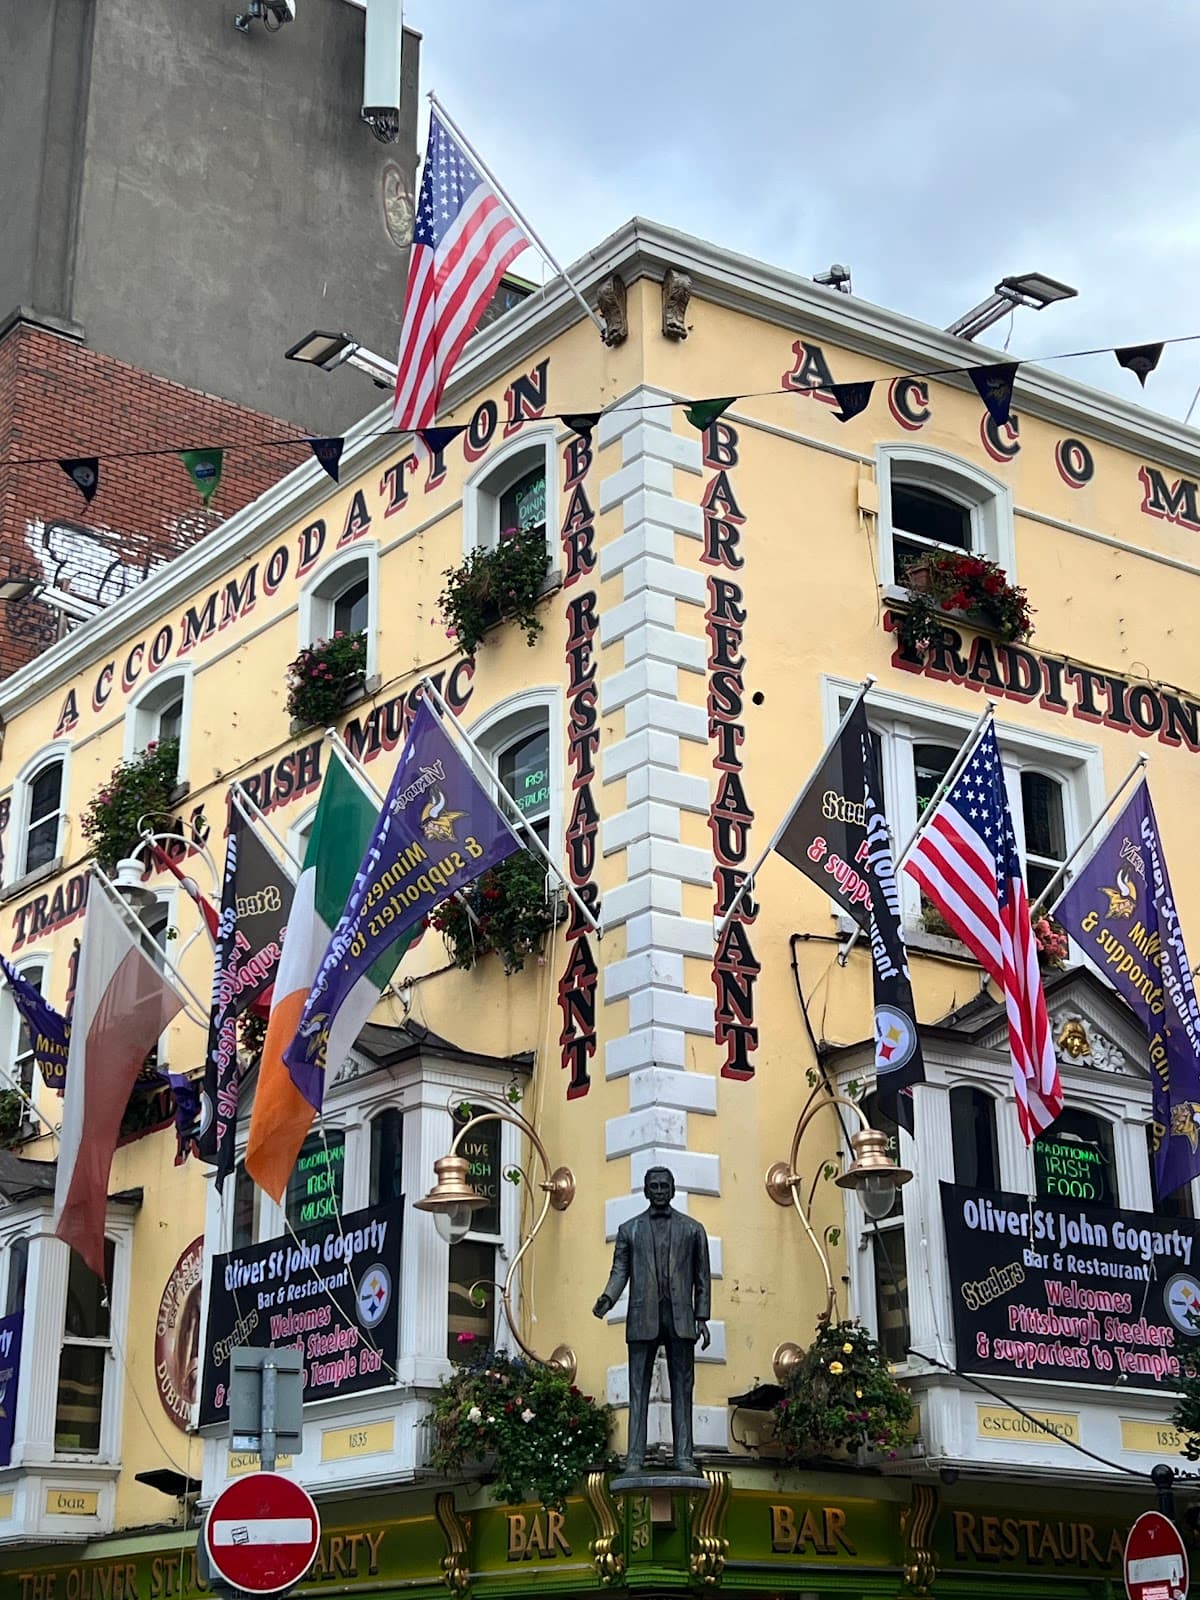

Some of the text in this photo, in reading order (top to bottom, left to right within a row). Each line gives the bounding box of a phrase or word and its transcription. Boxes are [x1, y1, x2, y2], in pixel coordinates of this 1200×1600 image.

[53, 357, 550, 738] ACCOMMODATION
[558, 433, 602, 1101] BAR RESTAURANT
[699, 419, 761, 1082] BAR RESTAURANT
[464, 1142, 489, 1157] LIVE
[1036, 1141, 1102, 1165] RADITIONAL
[1045, 1156, 1091, 1180] IRISH
[307, 1169, 335, 1195] IRISH
[1047, 1176, 1095, 1200] FOOD
[300, 1195, 340, 1223] MUSIC
[963, 1198, 1193, 1266] Oliver St John Gogarty
[225, 1218, 388, 1292] Oliver St John Gogarty
[1022, 1248, 1151, 1283] Bar & Restaurant
[257, 1292, 275, 1310] Bar
[277, 1286, 286, 1304] &
[286, 1268, 349, 1302] Restaurant
[961, 1261, 1026, 1312] Steelers
[1044, 1279, 1133, 1315] Welcomes
[269, 1304, 332, 1341] Welcomes
[1007, 1304, 1177, 1349] Pittsburgh Steelers
[306, 1323, 359, 1360] Steelers
[976, 1331, 991, 1358] &
[993, 1336, 1091, 1371] supporters
[1092, 1344, 1114, 1372] to
[1114, 1346, 1182, 1383] Temple
[310, 1354, 357, 1389] Temple
[359, 1347, 384, 1376] Bar
[349, 1431, 368, 1449] 1835
[1156, 1431, 1181, 1448] 1835
[506, 1510, 573, 1563] BAR
[769, 1504, 857, 1556] BAR
[19, 1571, 58, 1600] THE
[66, 1563, 139, 1600] OLIVER
